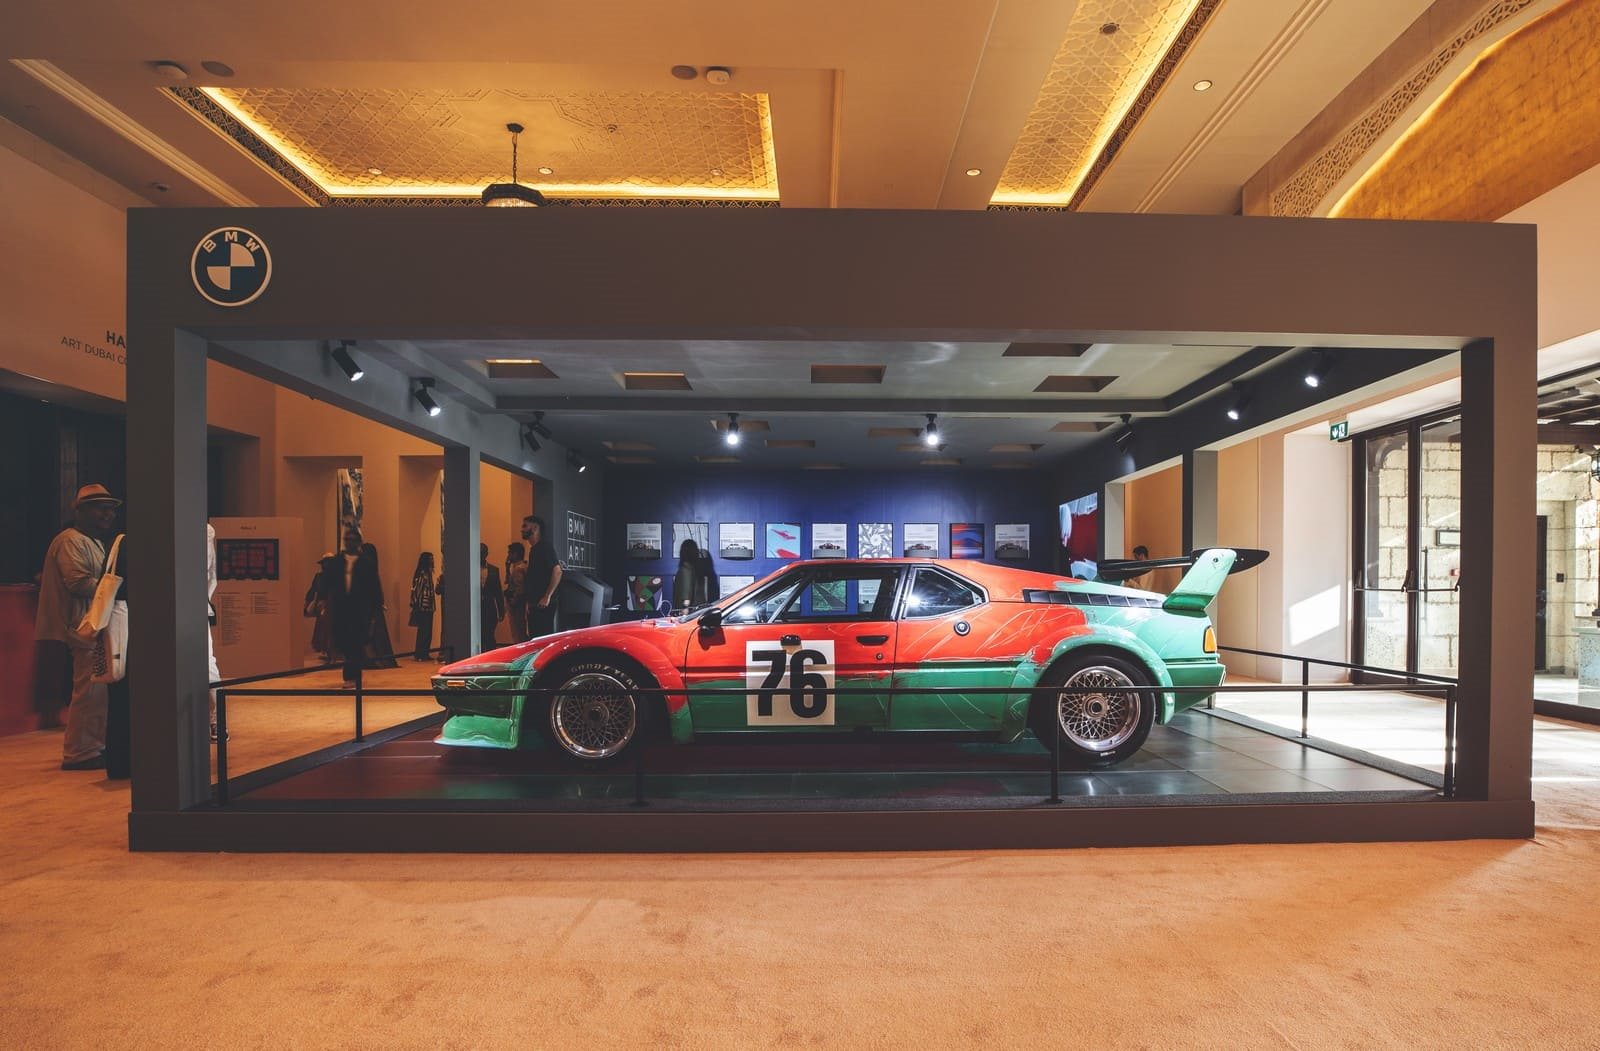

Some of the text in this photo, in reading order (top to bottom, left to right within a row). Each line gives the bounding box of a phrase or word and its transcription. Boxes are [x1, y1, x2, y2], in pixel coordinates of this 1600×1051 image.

[203, 231, 260, 253] BMW
[61, 336, 81, 350] ART
[84, 343, 115, 362] DUBAI
[569, 518, 585, 536] BMW
[568, 545, 585, 561] ART
[752, 649, 827, 718] 76
